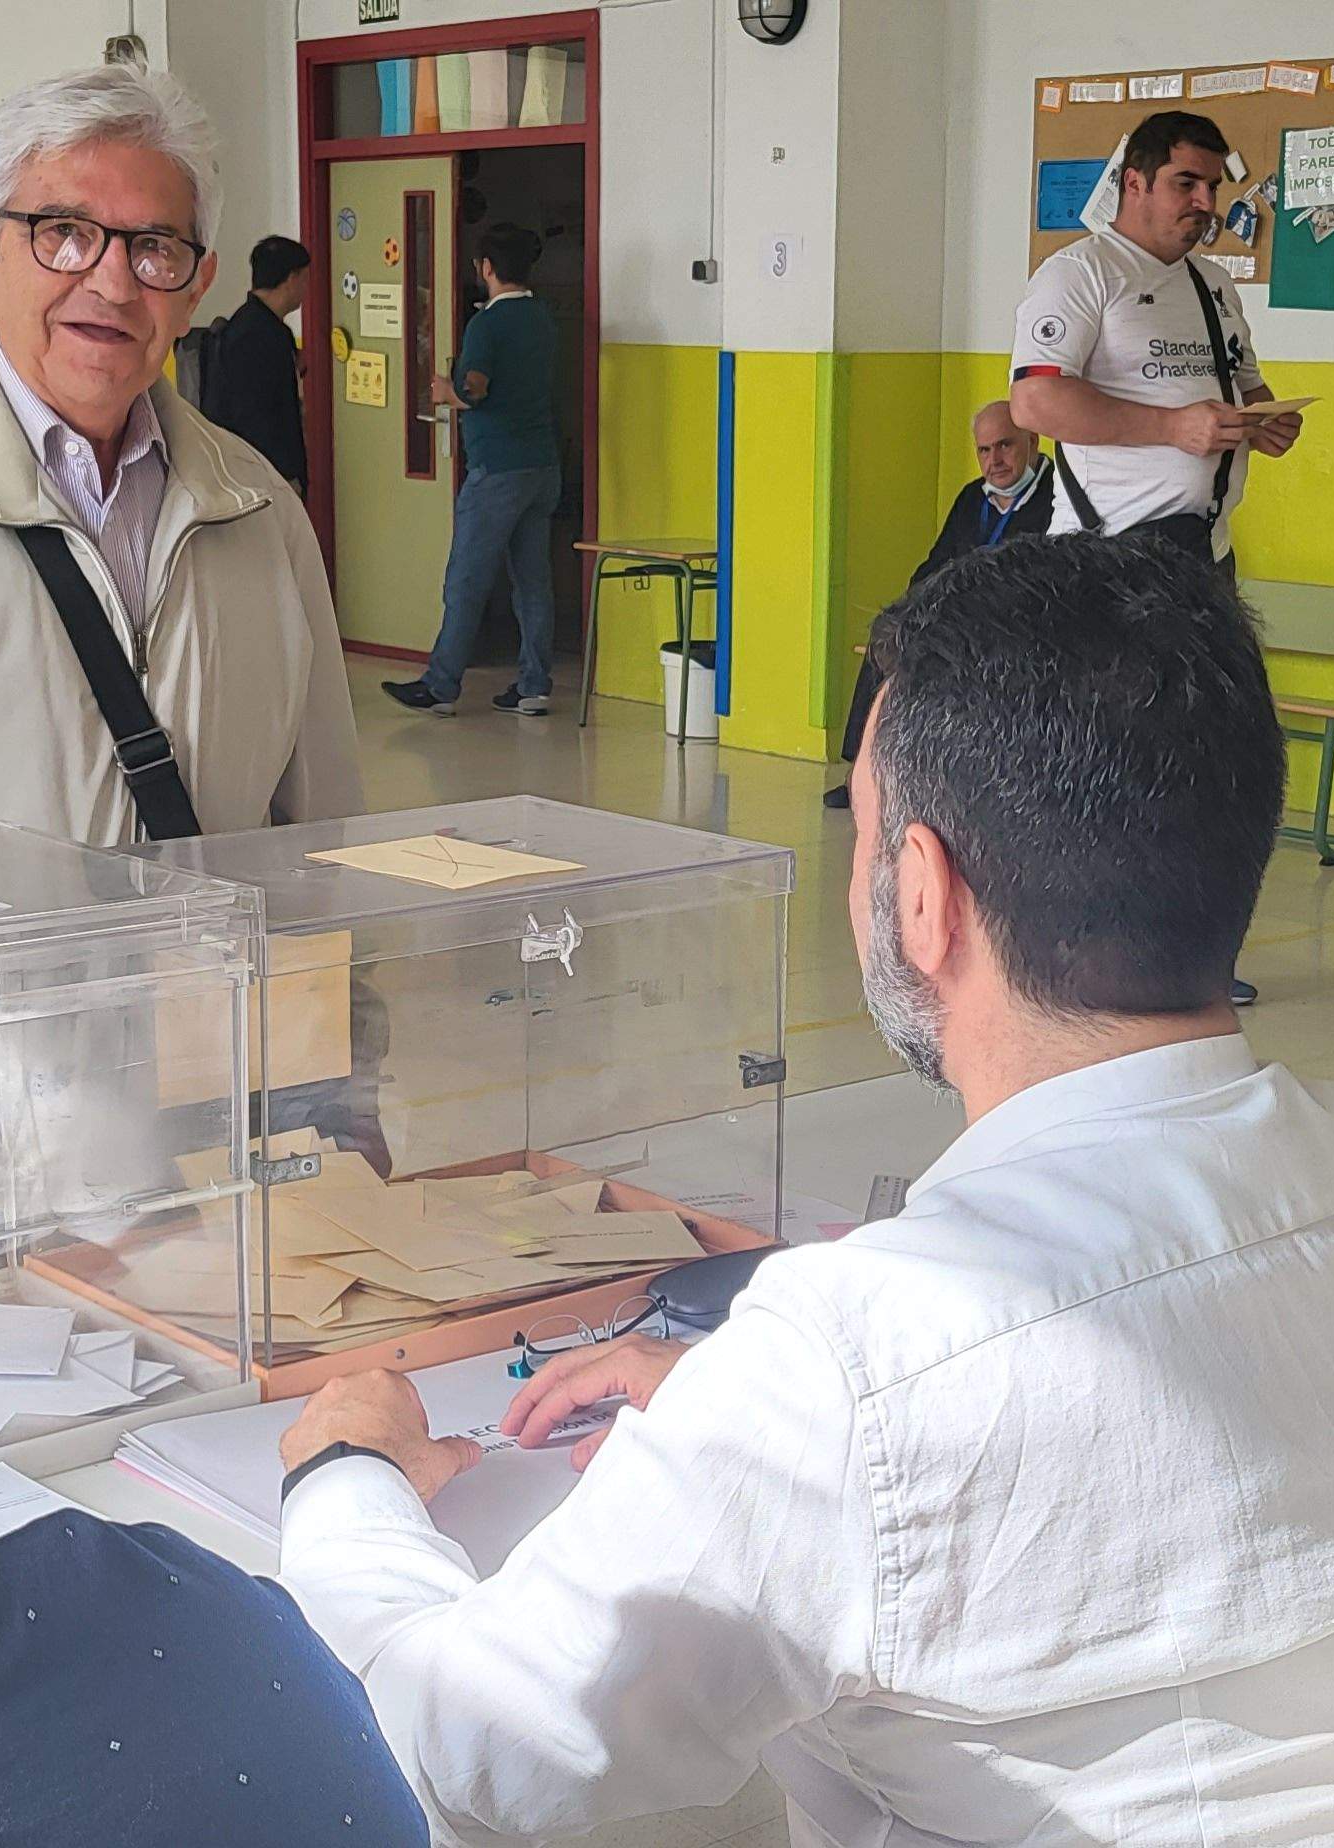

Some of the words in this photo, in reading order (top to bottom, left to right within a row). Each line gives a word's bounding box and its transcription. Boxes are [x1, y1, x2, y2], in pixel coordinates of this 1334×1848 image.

[359, 0, 399, 20] SALIDA
[773, 242, 787, 277] 3
[1148, 339, 1213, 357] Standar
[1141, 361, 1218, 380] Chartere
